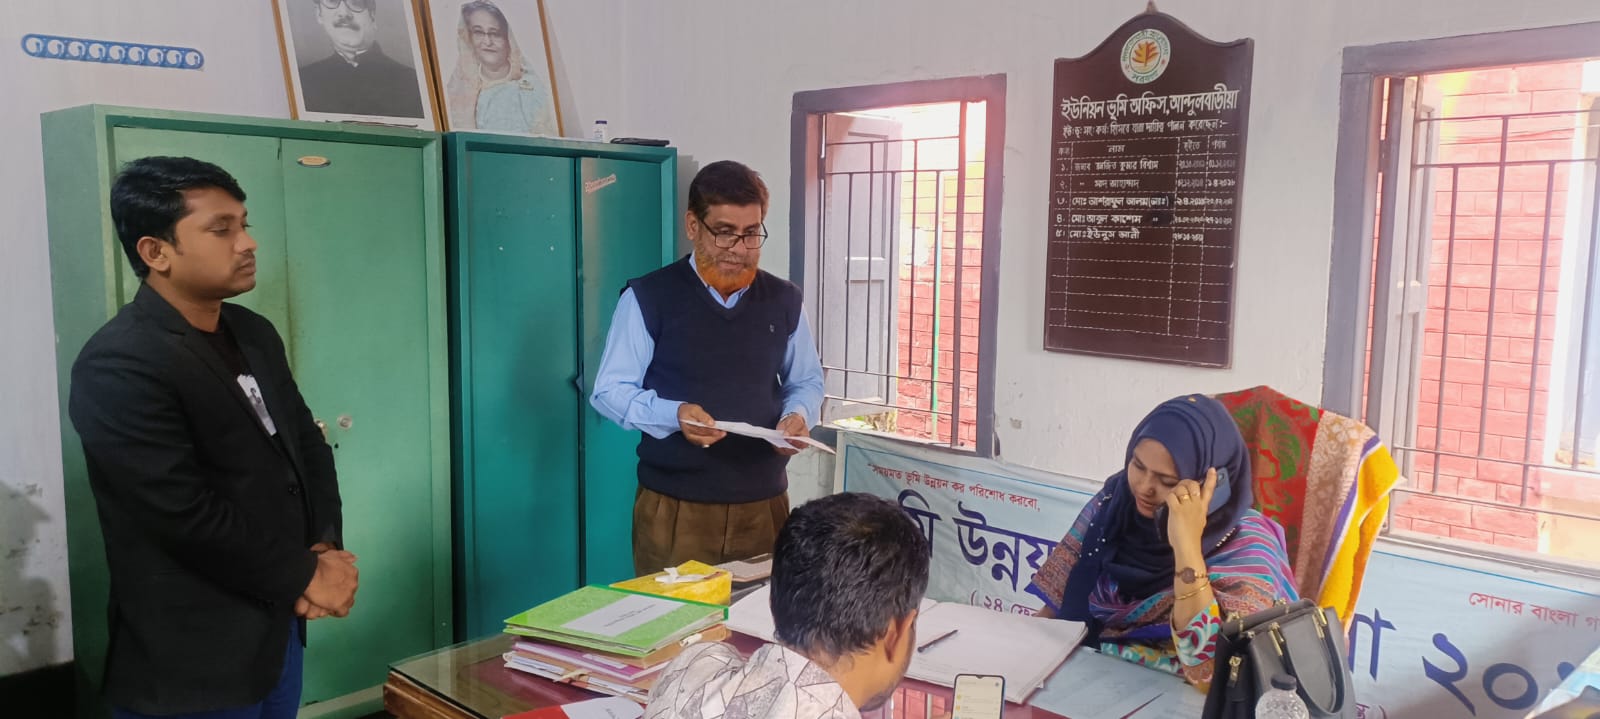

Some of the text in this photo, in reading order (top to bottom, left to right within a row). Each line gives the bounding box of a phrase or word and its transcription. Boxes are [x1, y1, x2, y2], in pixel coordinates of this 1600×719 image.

[1061, 95, 1105, 120] ইউনিয়ন
[924, 472, 950, 490] উন্নয়ন
[951, 481, 966, 494] কর
[969, 483, 1005, 502] পরিশোধ
[1469, 592, 1526, 615] সোনার
[1530, 603, 1580, 628] বাংলা
